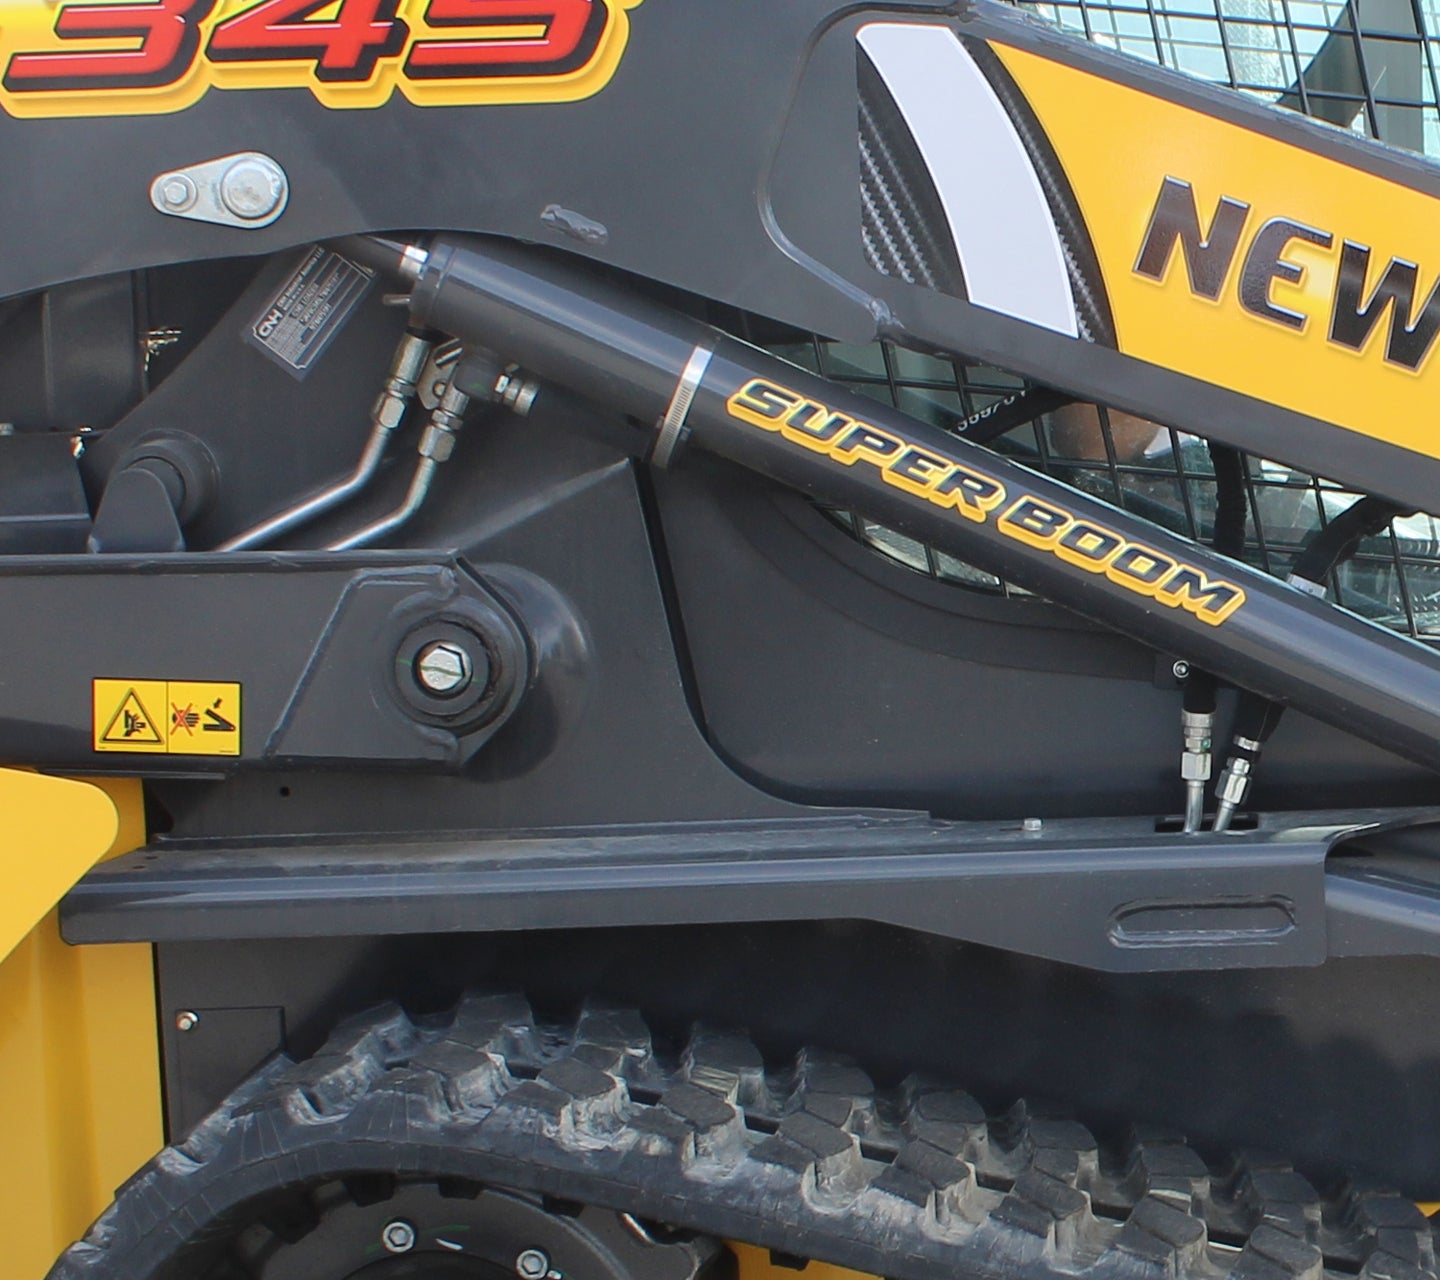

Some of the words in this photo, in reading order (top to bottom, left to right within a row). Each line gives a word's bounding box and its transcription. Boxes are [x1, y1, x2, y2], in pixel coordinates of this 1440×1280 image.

[256, 307, 284, 339] CNH
[727, 377, 1008, 523] SUPER
[997, 495, 1247, 627] BOOM
